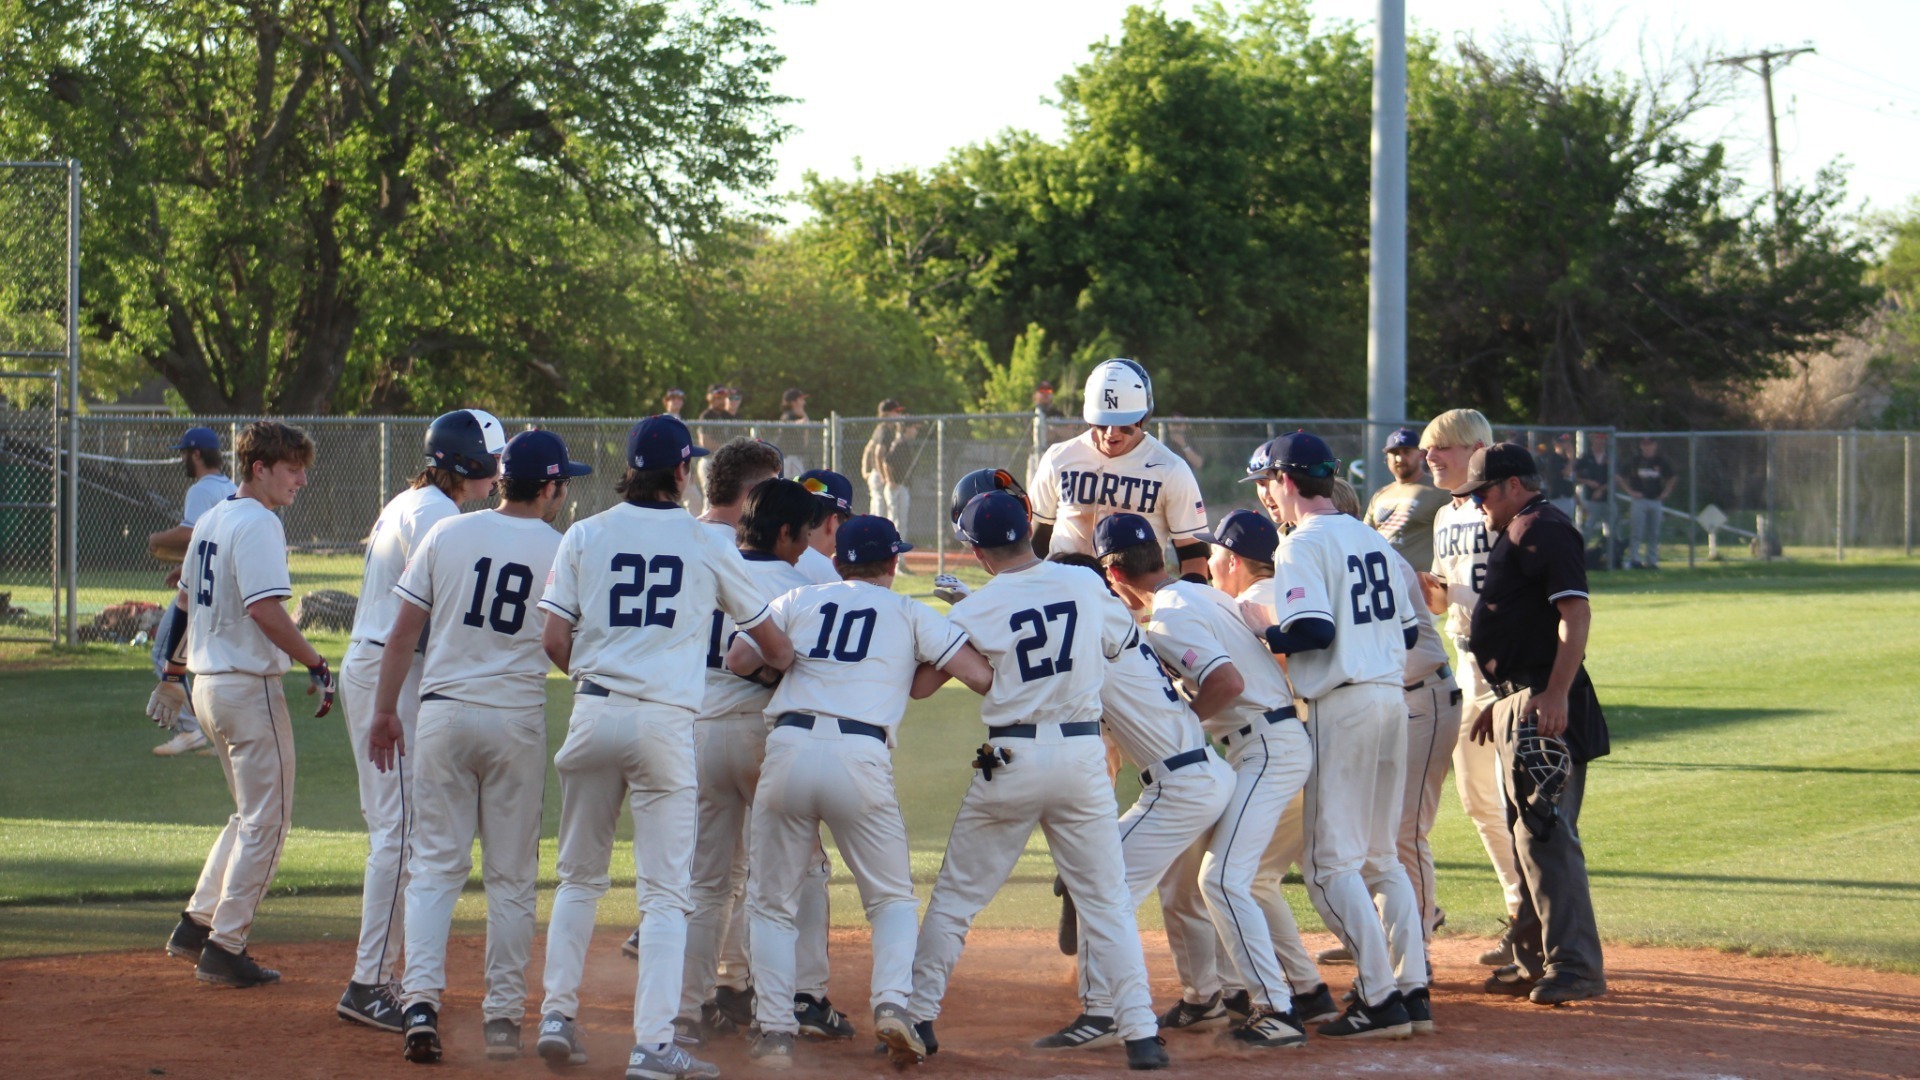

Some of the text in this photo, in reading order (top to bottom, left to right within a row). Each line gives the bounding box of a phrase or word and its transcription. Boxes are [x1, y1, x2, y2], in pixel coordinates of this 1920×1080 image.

[1061, 471, 1163, 514] NORTH
[197, 540, 218, 607] 15
[1434, 521, 1491, 559] ORTH
[471, 557, 534, 636] 18
[609, 552, 684, 629] 22
[1347, 551, 1396, 625] 28
[809, 602, 878, 662] 10
[1009, 600, 1078, 683] 27
